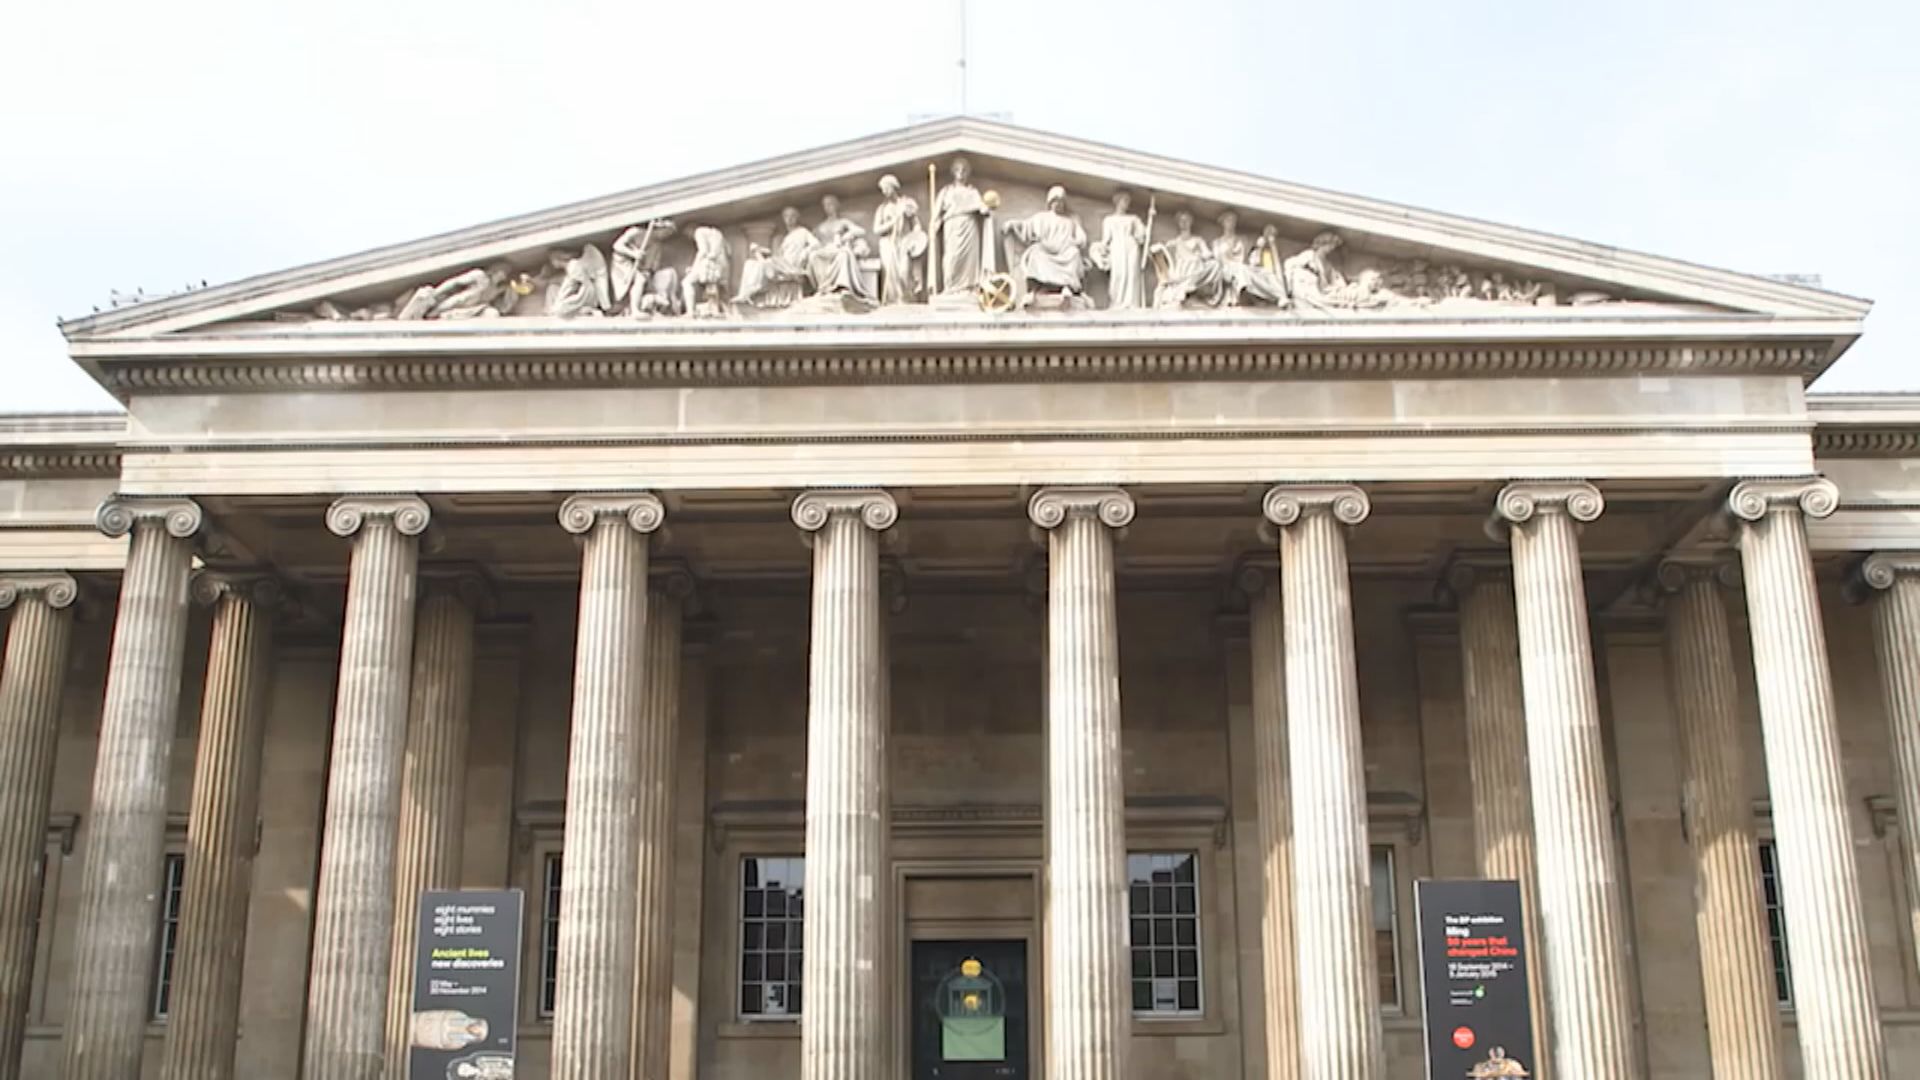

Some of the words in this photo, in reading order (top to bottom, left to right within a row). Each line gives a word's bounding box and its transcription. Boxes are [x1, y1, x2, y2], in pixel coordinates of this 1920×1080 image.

[457, 905, 495, 914] mummies
[1445, 915, 1459, 924] The
[1471, 915, 1504, 924] exhibition
[1445, 926, 1470, 938] Ming
[1461, 938, 1487, 948] years
[1488, 936, 1508, 946] that
[432, 948, 466, 958] Ancient
[467, 948, 489, 958] lives
[1447, 948, 1488, 958] changed
[1489, 948, 1517, 957] China
[431, 960, 451, 968] new
[453, 958, 504, 969] discoveries
